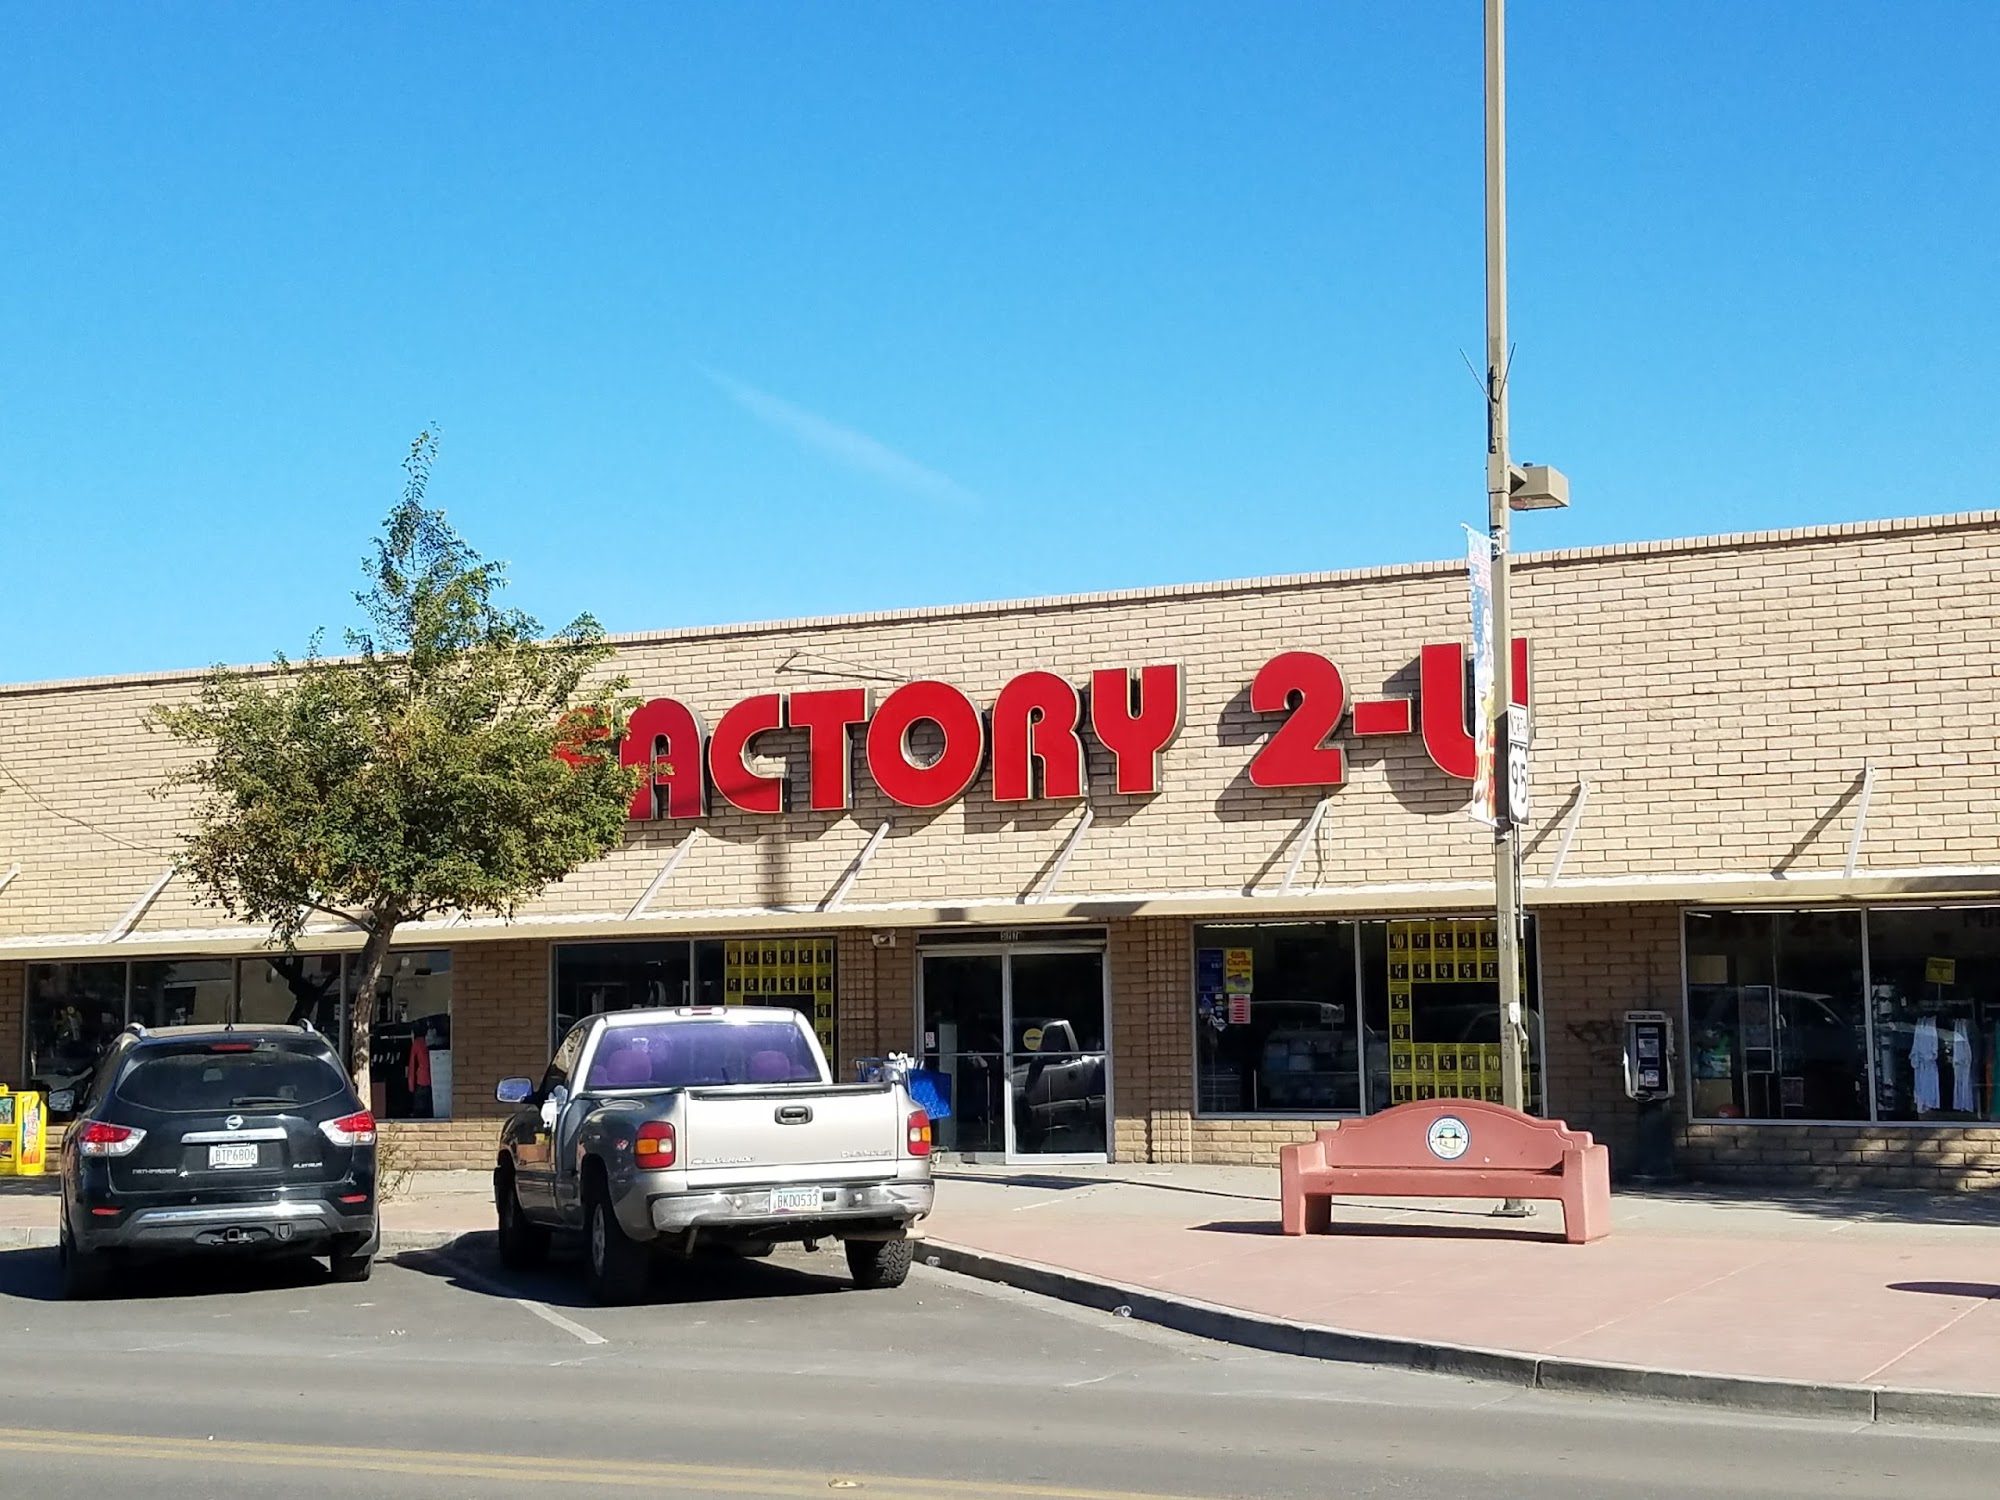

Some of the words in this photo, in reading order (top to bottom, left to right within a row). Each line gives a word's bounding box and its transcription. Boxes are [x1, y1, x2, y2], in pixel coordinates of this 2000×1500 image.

[1249, 637, 1532, 788] 2-U
[1511, 759, 1527, 804] 95
[777, 1193, 818, 1208] BKD0533
